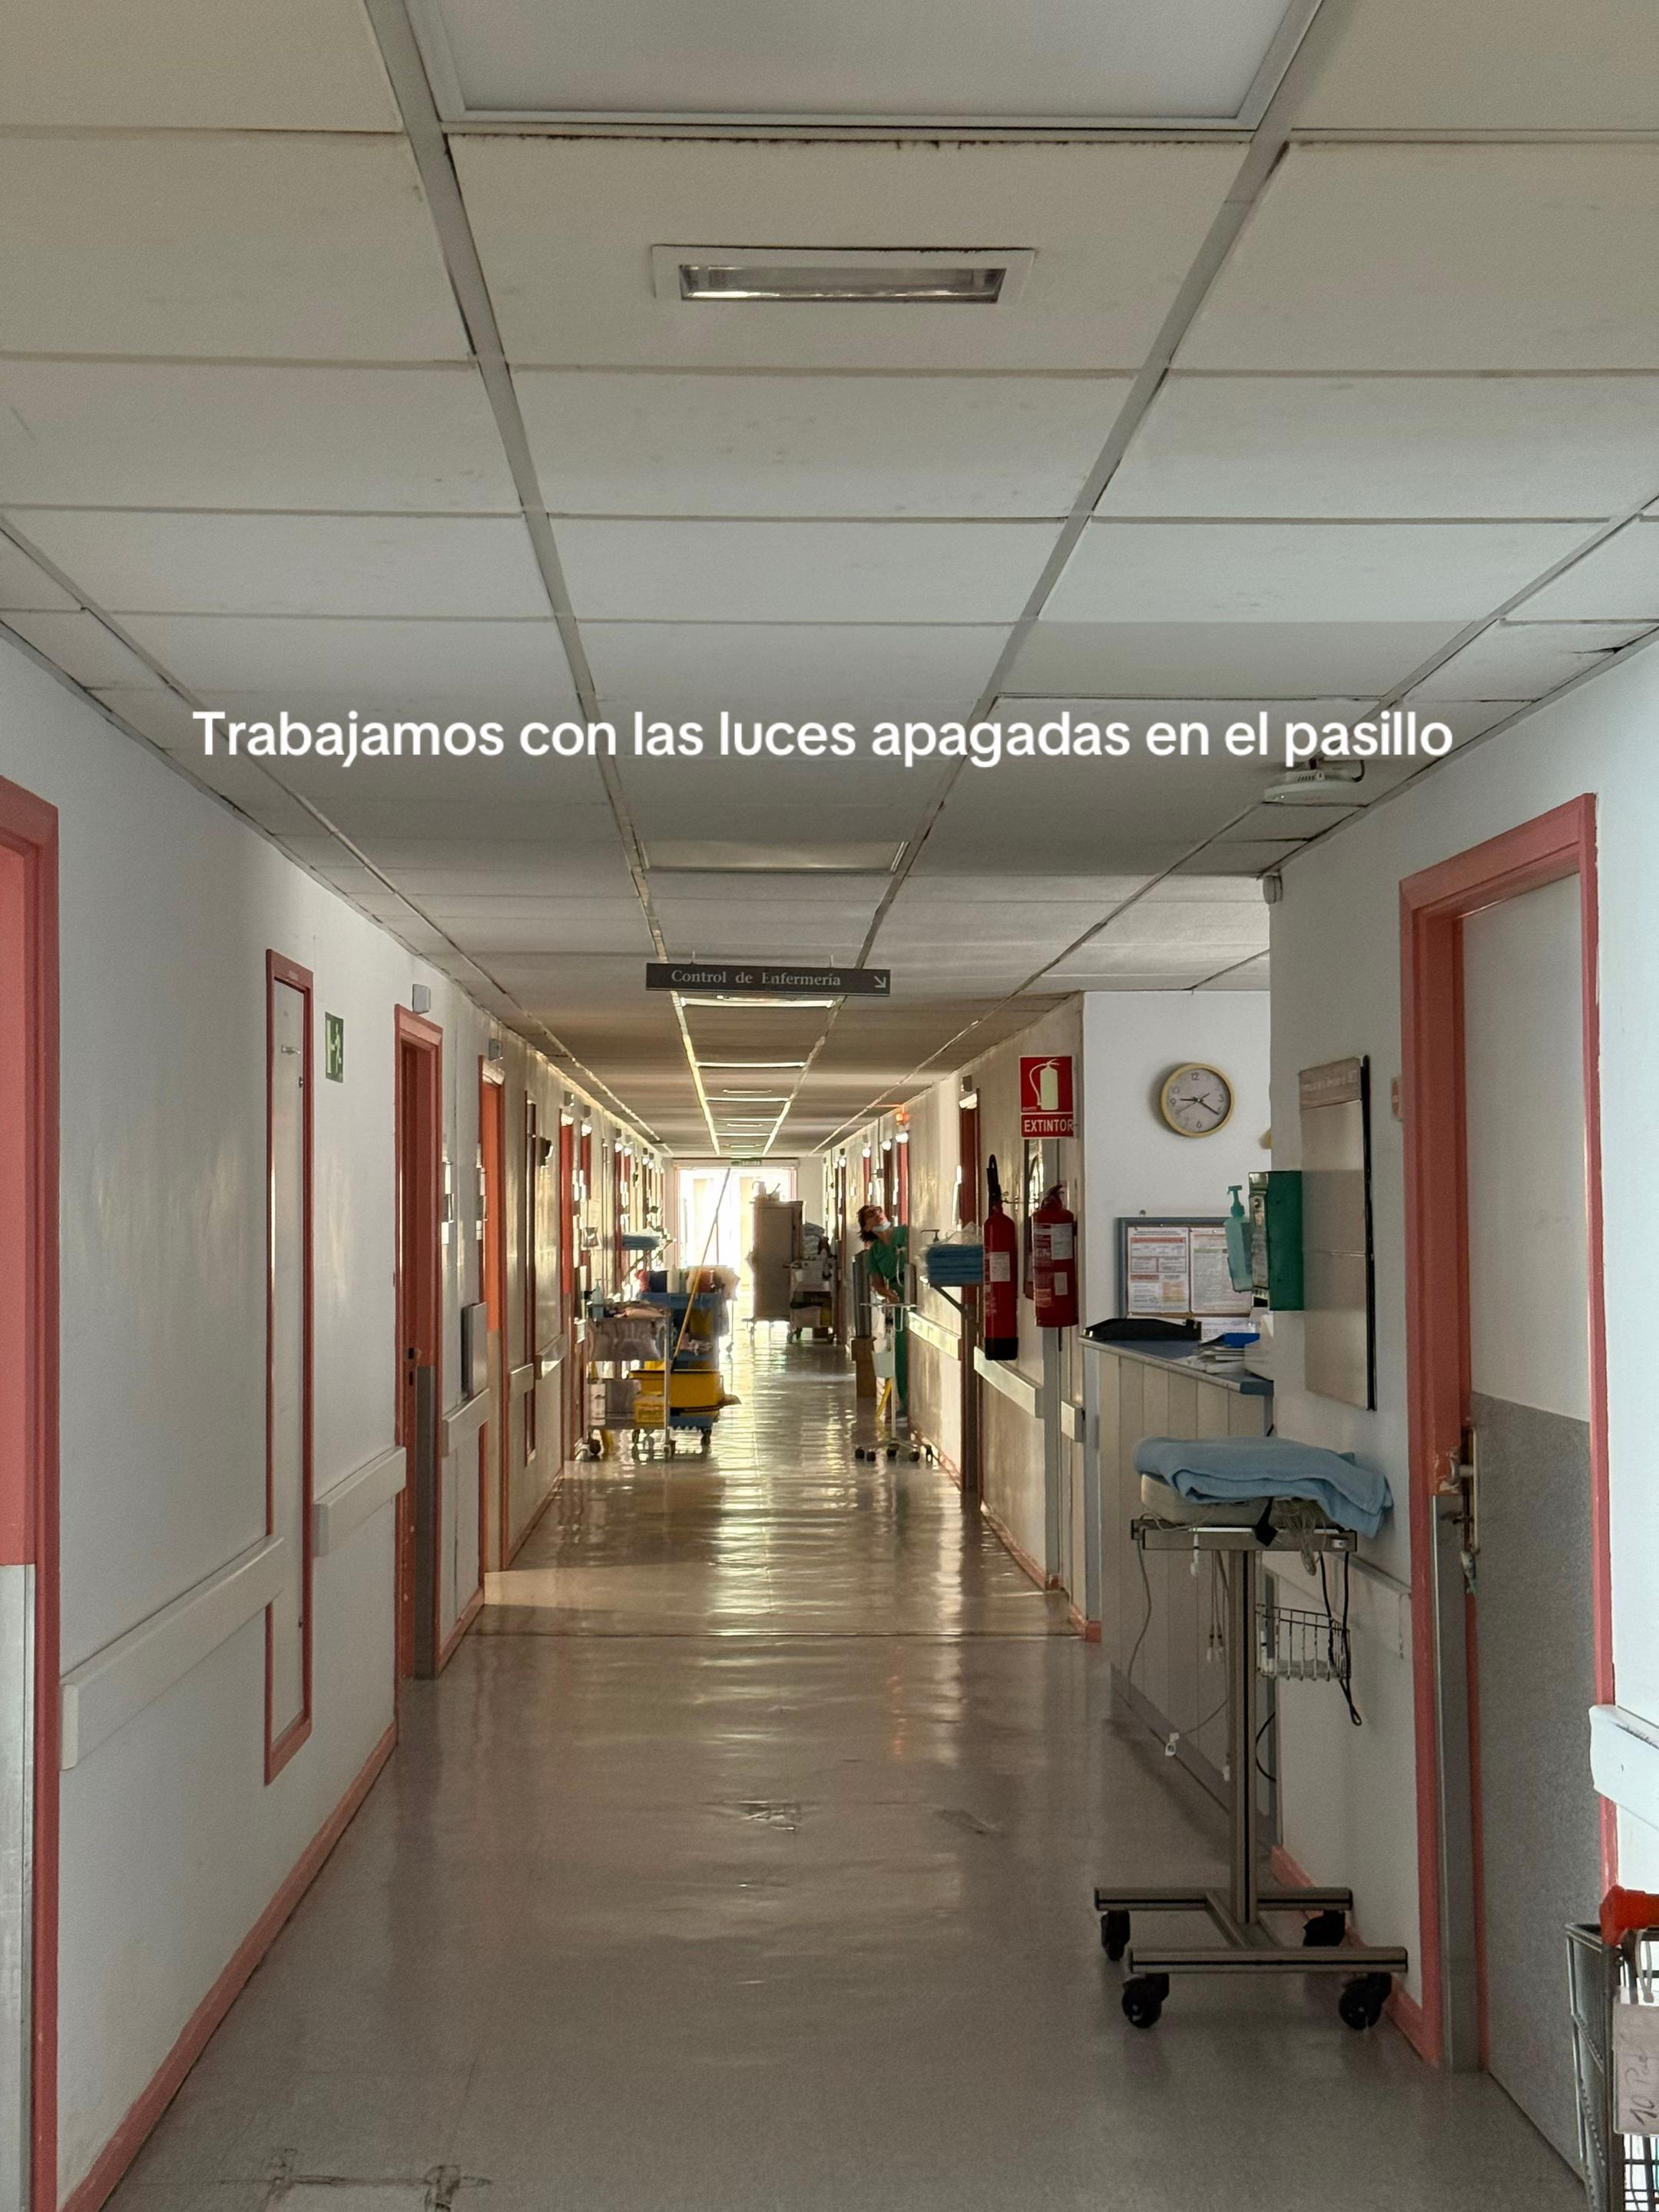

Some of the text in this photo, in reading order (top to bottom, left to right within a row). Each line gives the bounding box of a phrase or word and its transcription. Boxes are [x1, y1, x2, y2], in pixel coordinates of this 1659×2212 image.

[671, 969, 841, 986] Control de Enfermería
[1191, 1072, 1199, 1081] 12
[1170, 1098, 1177, 1106] 9
[1217, 1094, 1224, 1103] 3
[1024, 1119, 1074, 1133] EXTINTOR
[1629, 2094, 1657, 2127] 10
